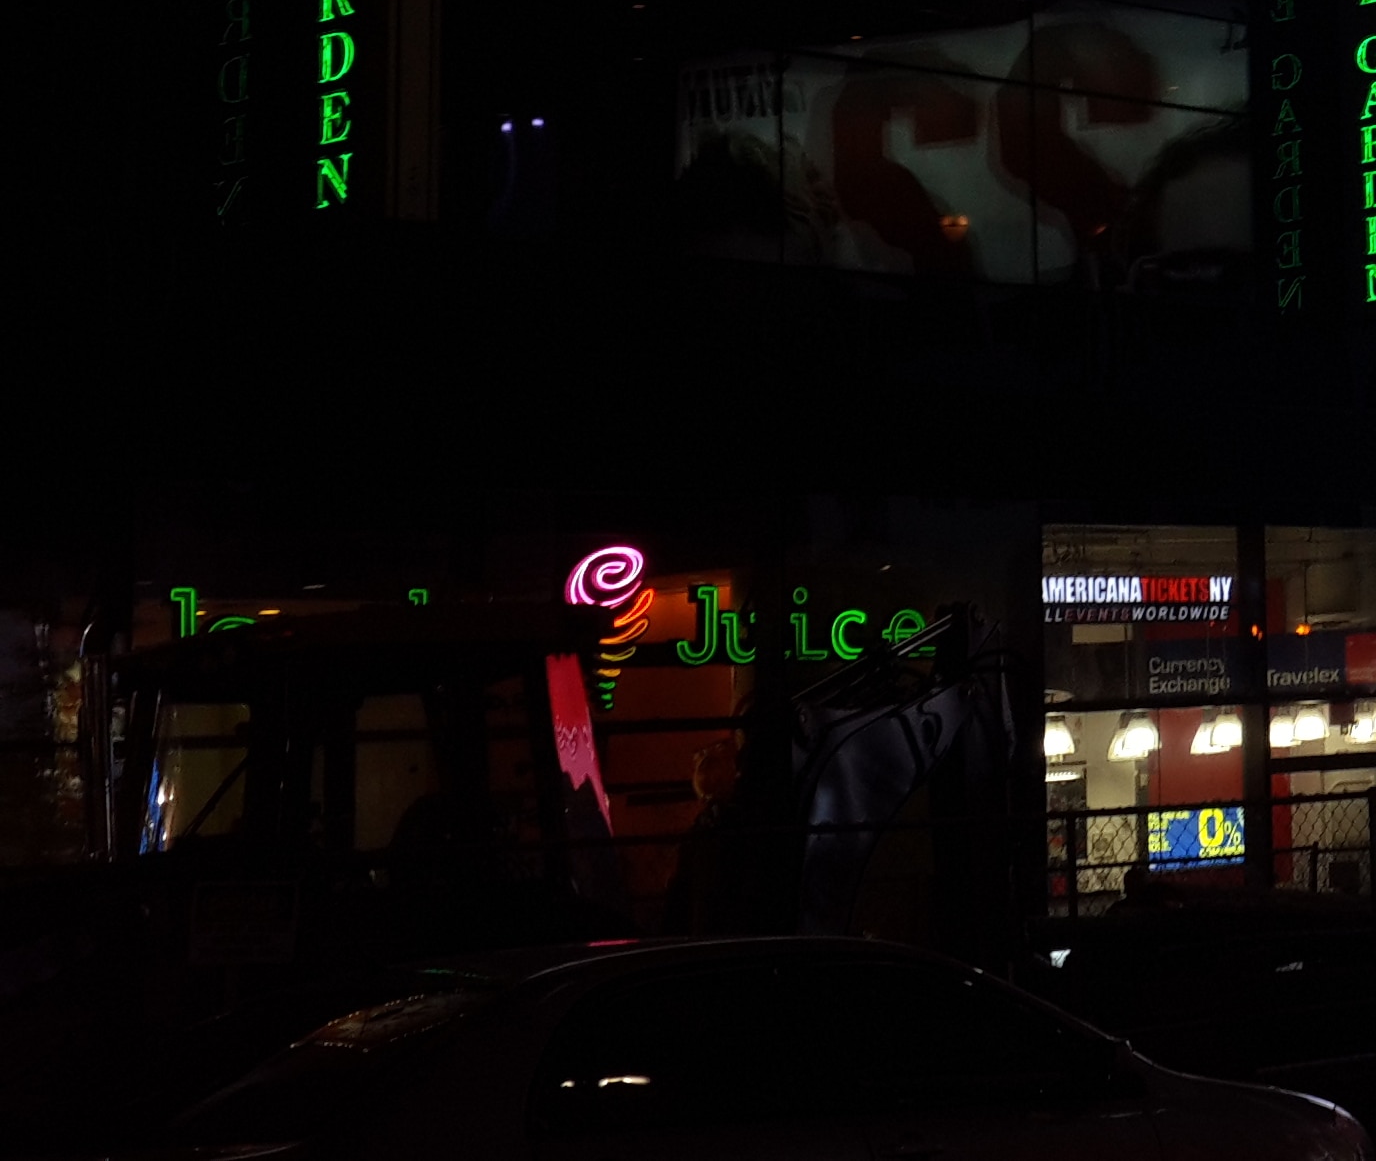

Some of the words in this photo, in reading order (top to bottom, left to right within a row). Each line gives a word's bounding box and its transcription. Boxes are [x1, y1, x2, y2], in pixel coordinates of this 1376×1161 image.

[677, 585, 940, 667] Juice
[1148, 656, 1226, 675] Currency
[1148, 675, 1231, 696] Exchange
[1266, 667, 1340, 687] Travelex
[1198, 807, 1242, 848] 0%
